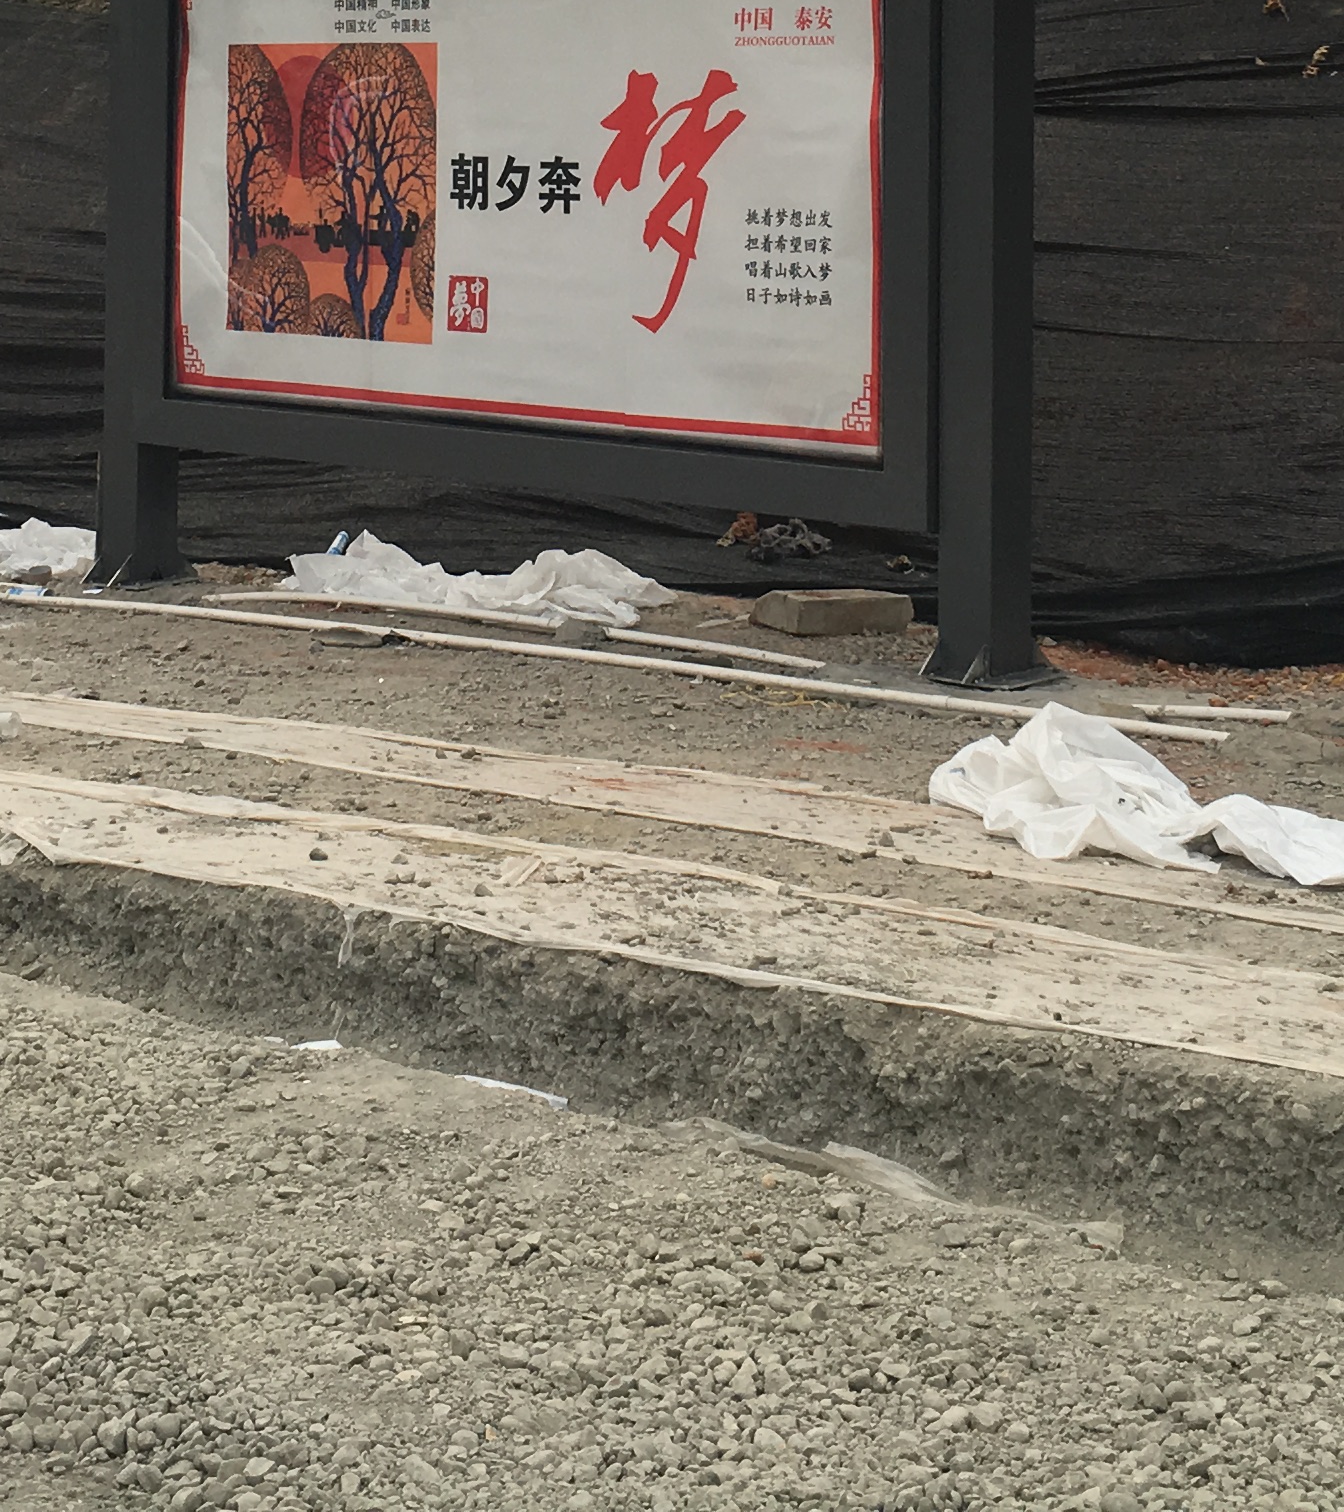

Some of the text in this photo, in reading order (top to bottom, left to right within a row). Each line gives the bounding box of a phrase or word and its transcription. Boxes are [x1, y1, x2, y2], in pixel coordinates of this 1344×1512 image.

[334, 18, 432, 34] 中国文化 中国表达
[734, 5, 833, 32] 中国 泰安
[734, 35, 836, 47] ZHONGGUOTAIAN
[745, 207, 833, 228] 挑着梦想出发
[744, 234, 833, 255] 担着希望回家
[744, 260, 833, 282] 唱着山歌入梦
[746, 287, 833, 307] 日子如诗如画
